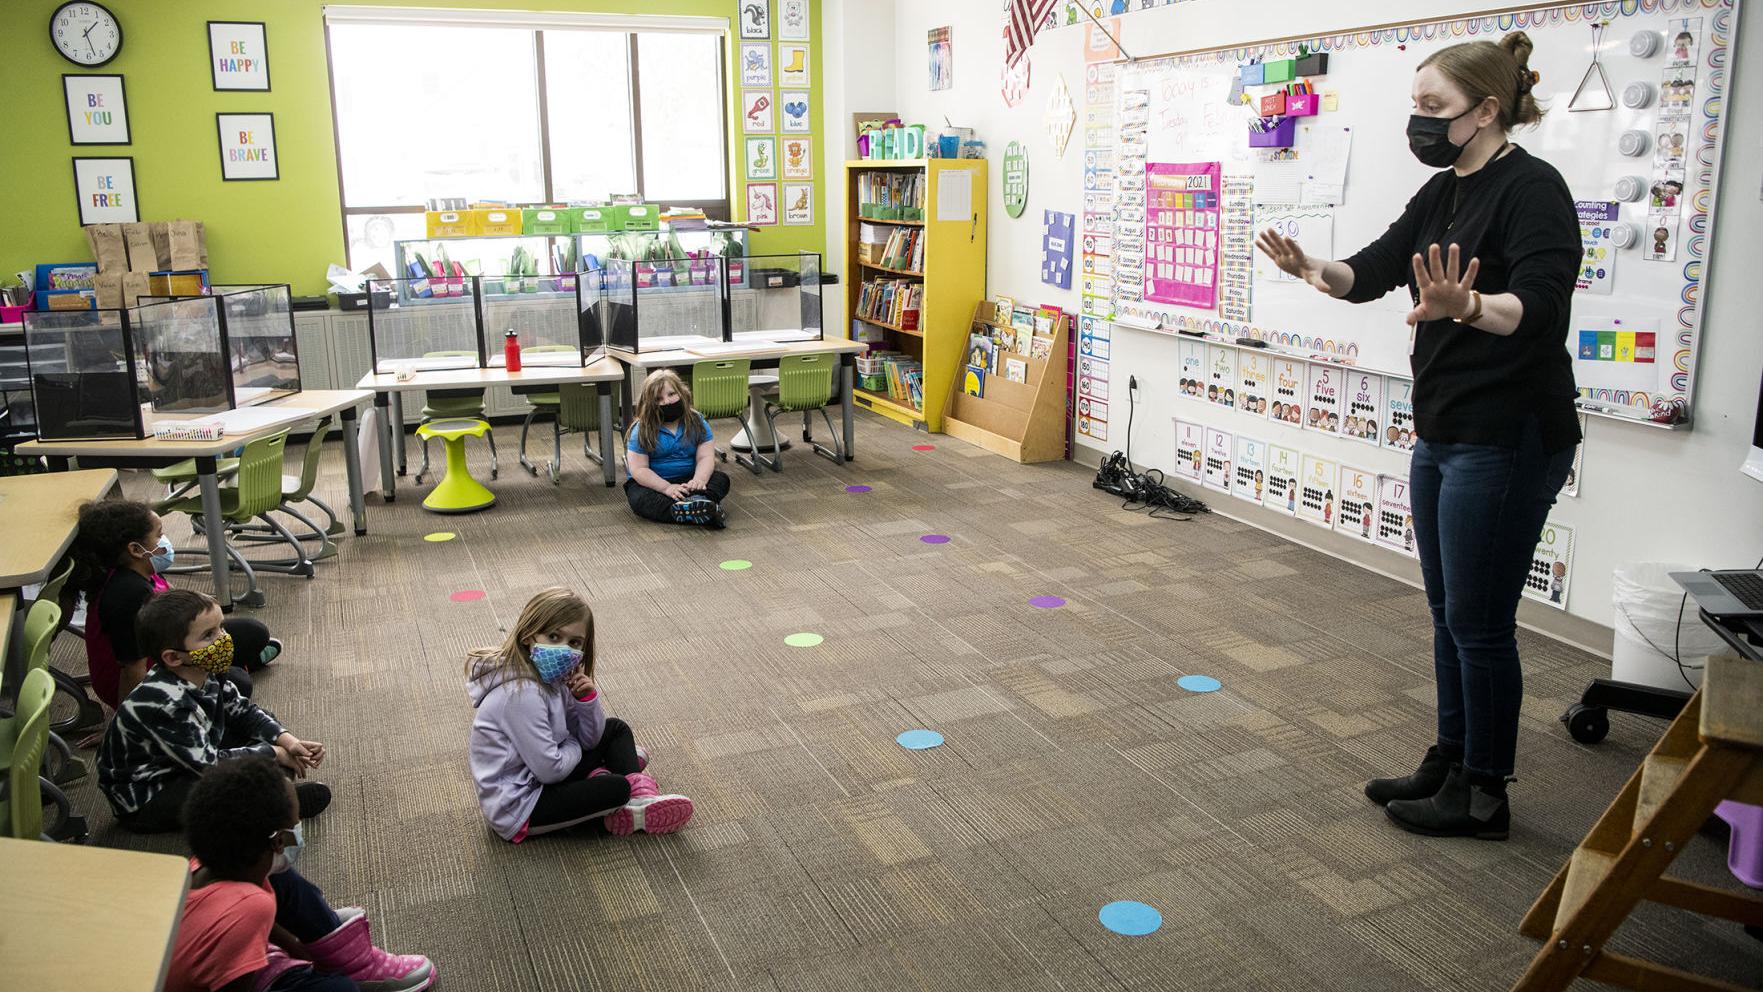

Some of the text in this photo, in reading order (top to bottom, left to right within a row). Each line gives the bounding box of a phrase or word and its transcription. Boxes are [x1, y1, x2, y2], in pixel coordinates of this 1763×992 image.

[69, 10, 76, 18] 11
[61, 18, 69, 26] 10
[230, 41, 246, 55] BE
[220, 59, 259, 73] HAPPY
[88, 93, 104, 108] BE
[84, 111, 112, 126] YOU
[239, 131, 255, 145] BE
[869, 128, 921, 160] READ
[229, 148, 268, 162] BRAVE
[752, 168, 770, 176] green
[97, 176, 113, 190] BE
[1188, 176, 1207, 188] 2021
[93, 194, 122, 208] FREE
[1578, 212, 1608, 221] ategies
[1186, 358, 1200, 367] one
[1220, 350, 1226, 363] 2
[1252, 355, 1257, 369] 3
[1215, 361, 1231, 374] two
[1243, 367, 1265, 382] three
[1286, 363, 1292, 378] 4
[1279, 373, 1299, 389] four
[1323, 370, 1329, 384] 5
[1361, 376, 1368, 391] 6
[1316, 380, 1335, 397] five
[1403, 384, 1411, 399] 7
[1357, 391, 1371, 403] six
[1391, 399, 1414, 412] seve
[1187, 426, 1191, 438] 11
[1182, 439, 1197, 448] eleven
[1216, 434, 1223, 447] 12
[1212, 448, 1227, 457] twelve
[1248, 443, 1255, 456] 13
[1240, 456, 1261, 466] thirteen
[1280, 451, 1288, 465] 14
[1272, 464, 1294, 476] fourteen
[1316, 463, 1323, 476] 15
[1309, 475, 1329, 488] fifteen
[1354, 474, 1363, 489] 16
[1347, 489, 1367, 500] sixteen
[1394, 484, 1405, 499] 17
[1382, 499, 1411, 513] seventee
[1536, 547, 1560, 561] wenty
